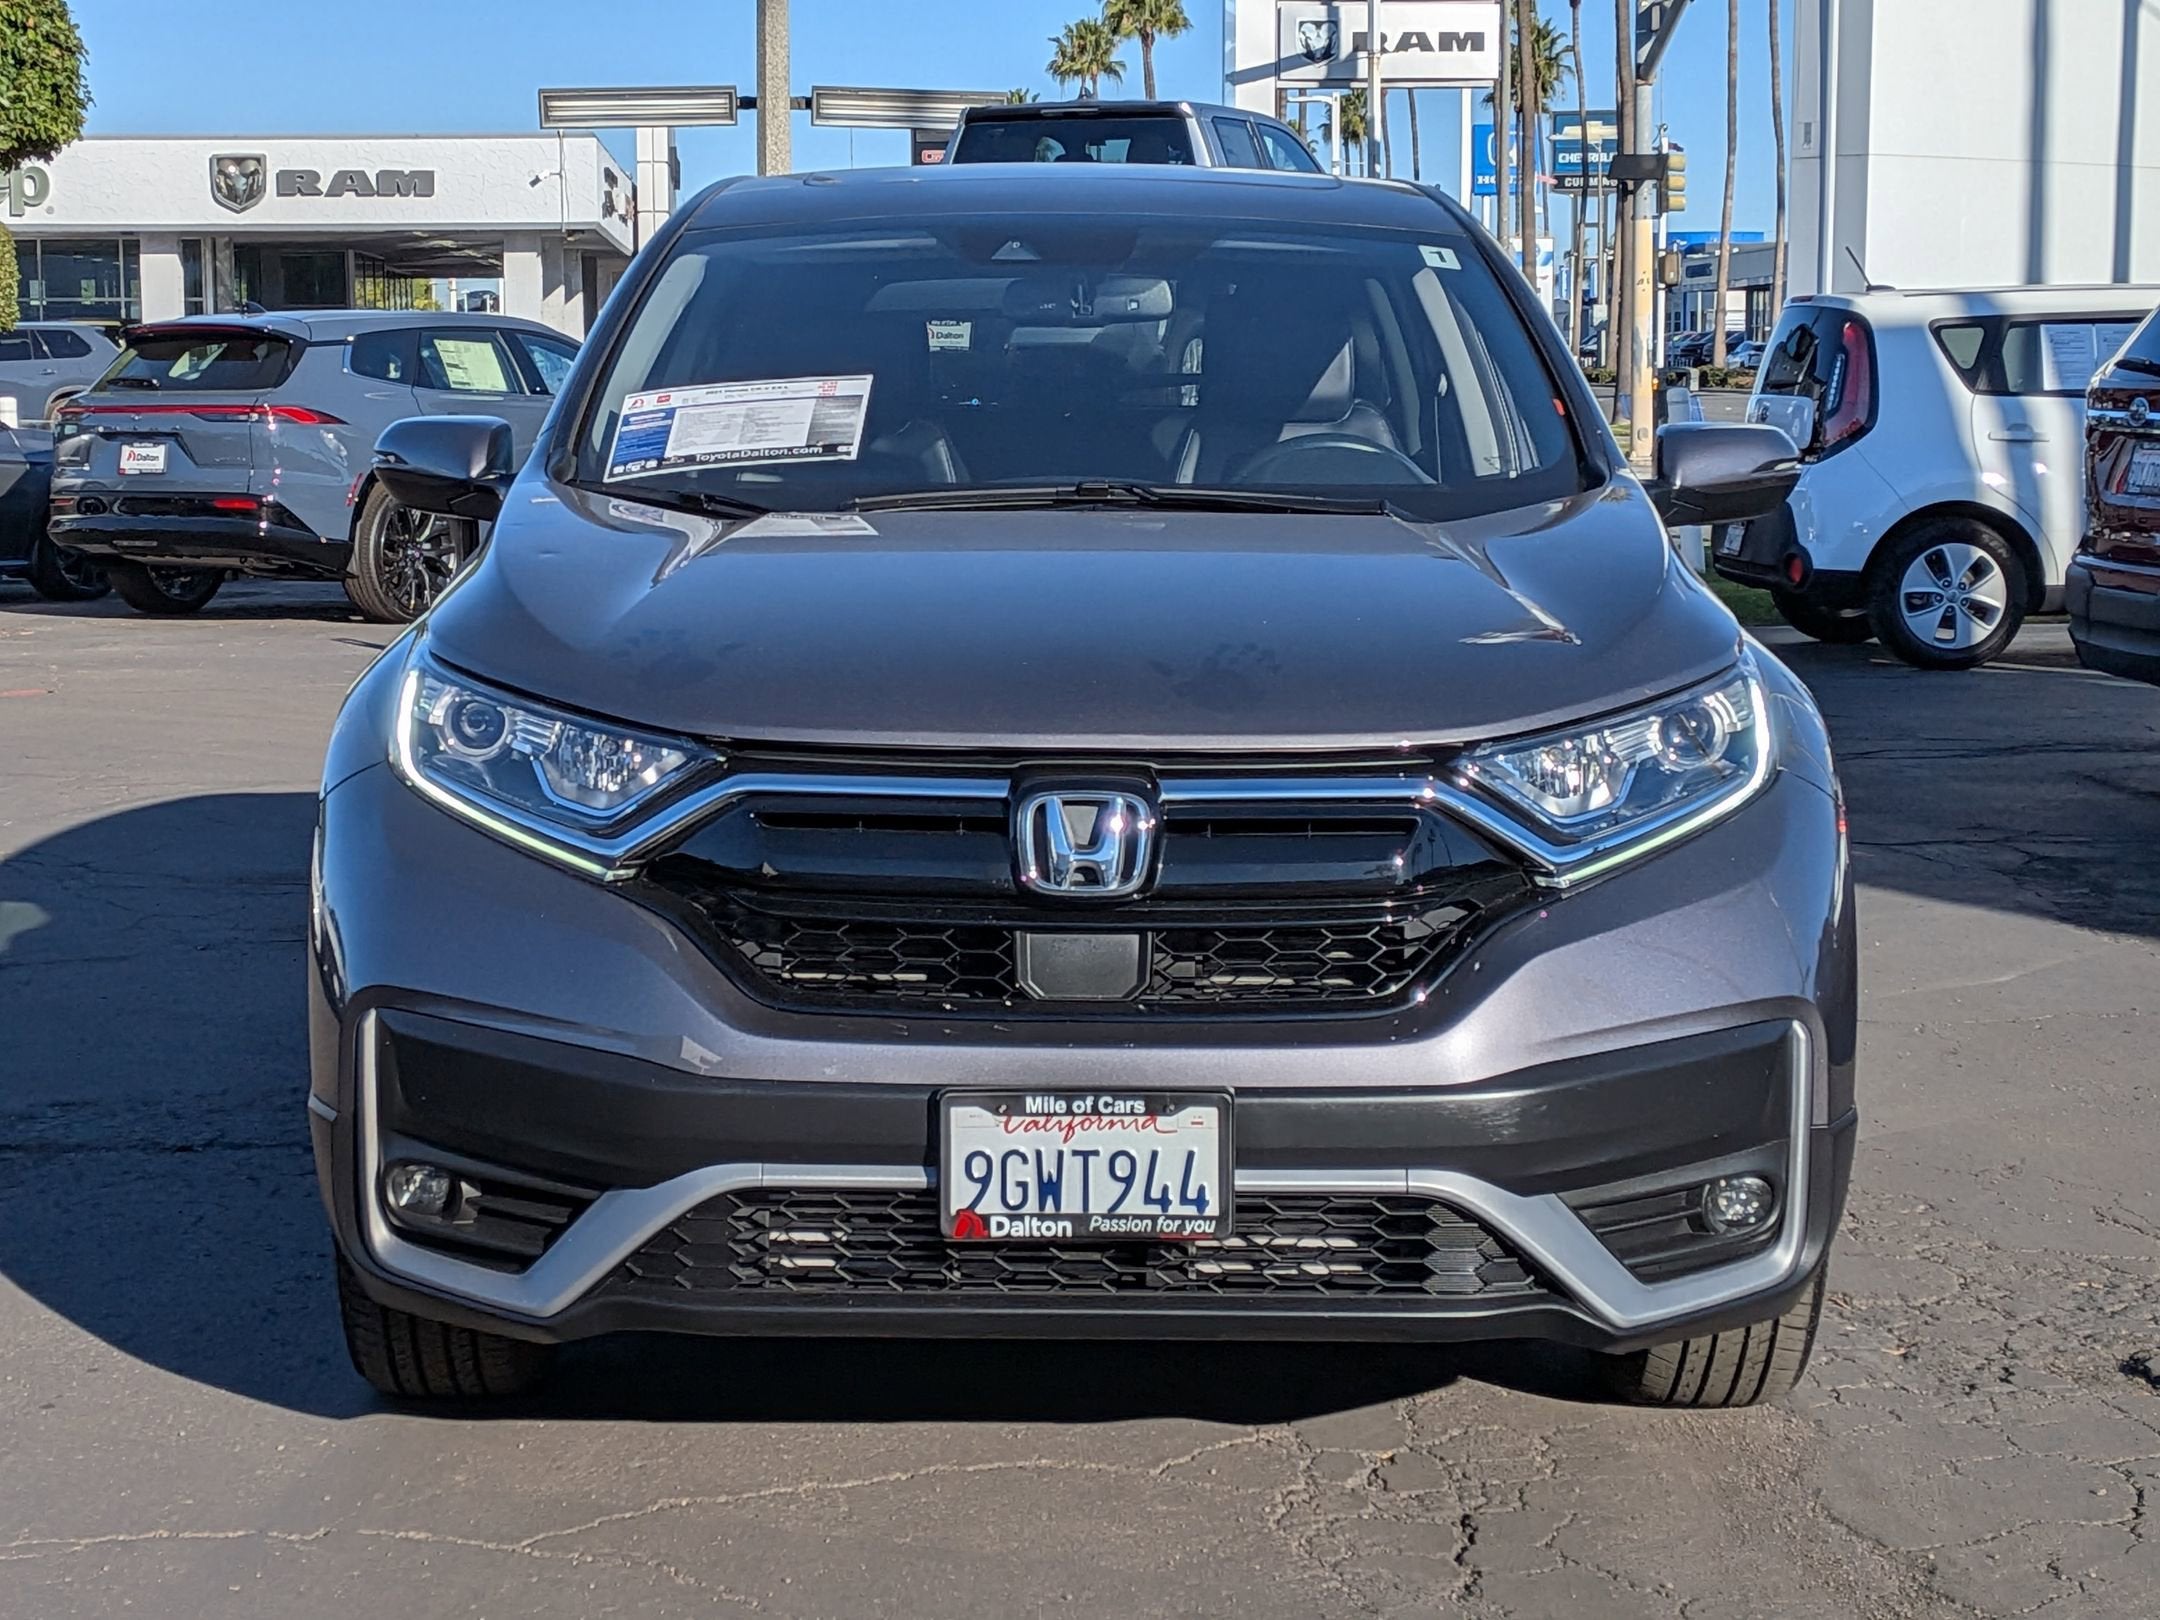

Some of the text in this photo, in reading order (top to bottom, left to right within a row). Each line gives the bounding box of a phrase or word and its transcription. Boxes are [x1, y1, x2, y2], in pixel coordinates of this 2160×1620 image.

[1352, 32, 1485, 52] RAM
[276, 169, 435, 197] RAM
[936, 331, 964, 339] Dalton
[136, 453, 160, 462] Dalton
[695, 446, 823, 463] ToyotaDalton.com
[1025, 1096, 1146, 1114] Mile of Cars
[1001, 1114, 1178, 1144] California
[964, 1148, 1210, 1214] 9GWT944
[990, 1215, 1216, 1238] Dalton Passion for you
